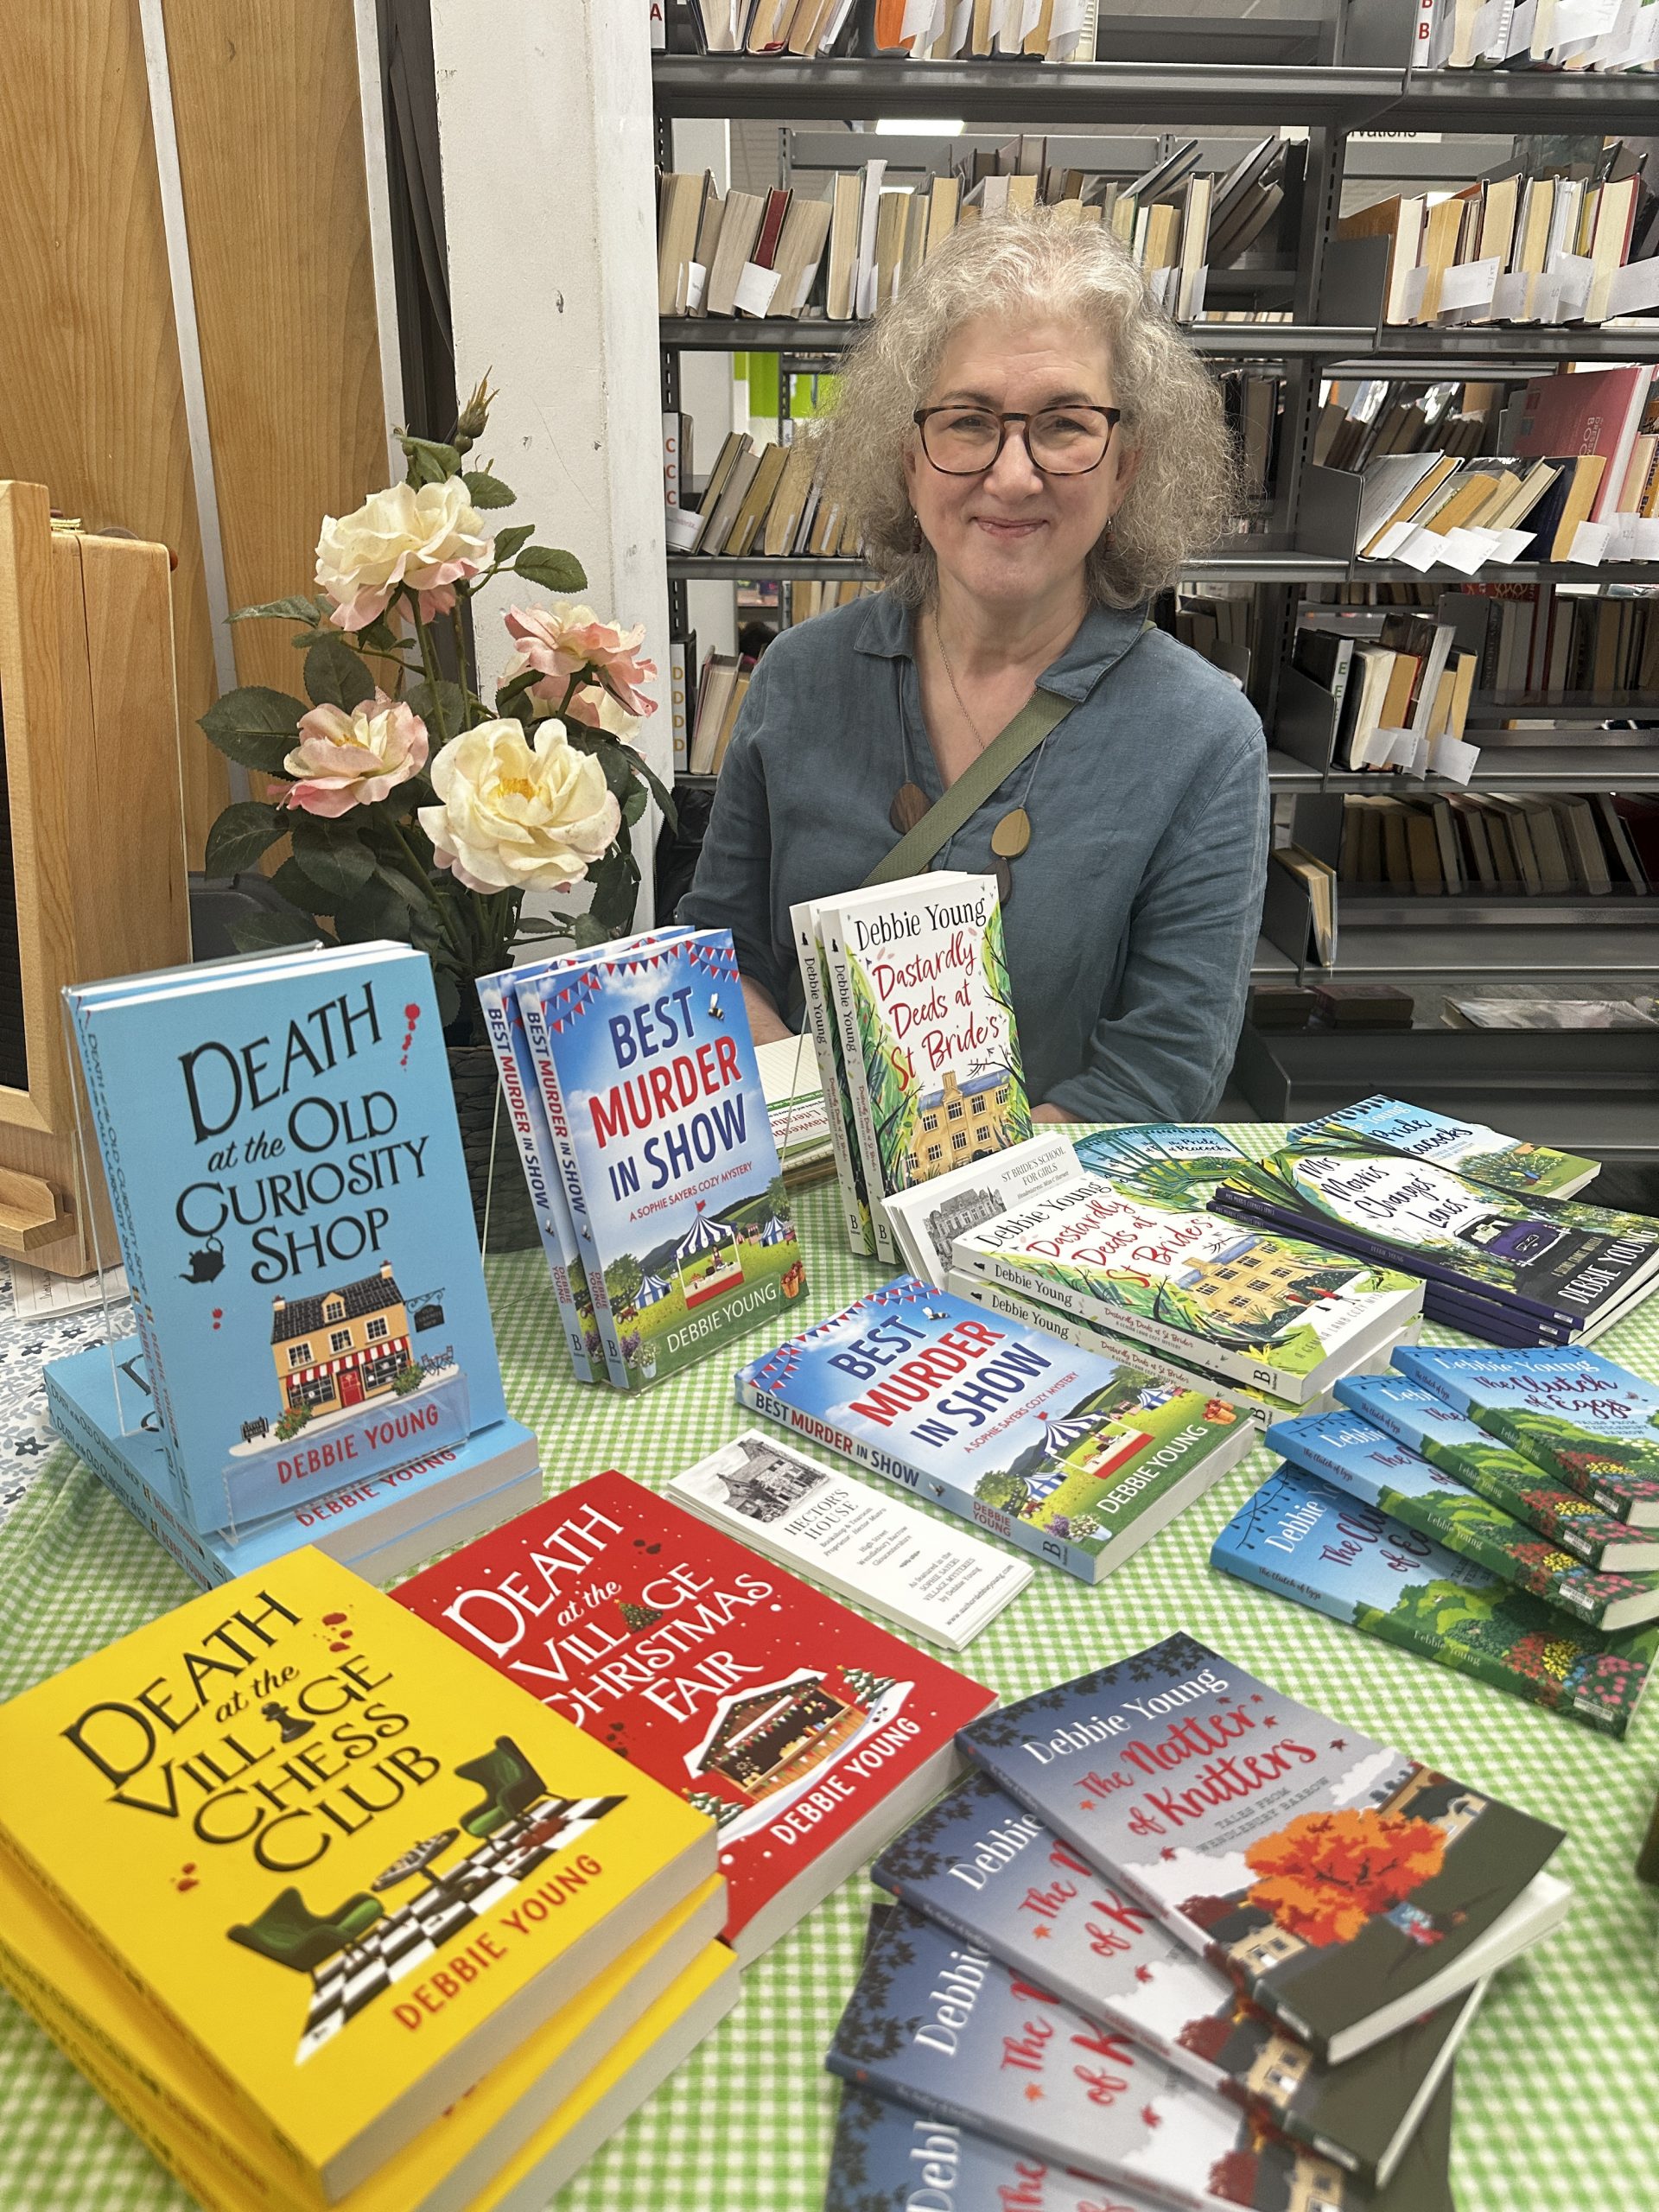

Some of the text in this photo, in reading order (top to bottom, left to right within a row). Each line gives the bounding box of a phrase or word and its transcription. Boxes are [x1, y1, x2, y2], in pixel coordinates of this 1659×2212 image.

[650, 3, 662, 21] A
[1419, 22, 1430, 39] B
[665, 438, 676, 453] C
[666, 464, 676, 479] C
[667, 491, 677, 505] C
[672, 667, 683, 680] D
[1338, 662, 1347, 674] E
[673, 691, 683, 704] D
[674, 715, 684, 728] D
[675, 739, 684, 751] D
[855, 898, 987, 950] Debbie Young
[872, 931, 976, 1001] Dastardly
[804, 957, 827, 1044] Debbie Young
[835, 964, 857, 1052] Debbie Young
[889, 980, 971, 1039] Deeds at
[608, 986, 695, 1070] BEST
[178, 981, 382, 1145] DEATH
[891, 1046, 916, 1091] St
[487, 1008, 550, 1210] BEST MURDER IN SHOW
[526, 1012, 586, 1215] BEST MURDER IN SHOW
[588, 1036, 743, 1148] MURDER
[207, 1091, 397, 1173] at the OLD
[608, 1093, 747, 1202] IN SHOW
[1368, 1118, 1432, 1141] Pride
[176, 1135, 429, 1237] CURIOSITY
[1001, 1146, 1066, 1182] ST BRIDE'S SCHOOL
[1022, 1163, 1058, 1185] FOR GIRLS
[1298, 1157, 1340, 1179] Mrs
[630, 1161, 753, 1223] A SOPHIE SAYERS COZY MYSTERY
[975, 1180, 1112, 1248] Debbie Young
[1354, 1177, 1440, 1218] Changes
[1406, 1198, 1469, 1229] Lanes
[251, 1207, 389, 1284] SHOP
[1026, 1199, 1135, 1257] Dastardly
[1071, 1216, 1157, 1266] Deeds at
[995, 1263, 1073, 1308] Debbie Young
[1106, 1265, 1152, 1289] St
[1558, 1264, 1622, 1306] DEBBIE
[1598, 1228, 1659, 1266] YOUNG
[666, 1282, 778, 1354] DEBBIE YOUNG
[992, 1295, 1070, 1340] Debbie Young
[828, 1314, 928, 1381] BEST
[1434, 1357, 1599, 1374] Debbie Young
[849, 1320, 1008, 1427] MURDER
[910, 1342, 1053, 1448] IN SHOW
[1254, 1370, 1270, 1385] B
[1469, 1373, 1618, 1393] The Clutch
[964, 1371, 1080, 1453] A SOPHIE SAYERS COZY MYSTERY
[1524, 1394, 1632, 1420] of Eggs
[276, 1403, 439, 1484] DEBBIE YOUNG
[755, 1392, 920, 1487] BEST MURDER IN SHOW
[1363, 1451, 1412, 1468] The
[1096, 1424, 1208, 1514] DEBBIE YOUNG
[784, 1489, 849, 1535] HECTOR'S
[804, 1501, 859, 1540] HOUSE
[973, 1502, 1011, 1527] DEBBIE
[973, 1510, 1012, 1538] YOUNG
[1264, 1499, 1327, 1554] Debbie
[1427, 1514, 1484, 1550] Debbie Young
[919, 1557, 960, 1592] SOPHIE SAYERS
[1319, 1540, 1363, 1567] The
[1380, 1549, 1421, 1573] of
[441, 1503, 625, 1660] DEATH
[556, 1580, 622, 1628] at the
[923, 1557, 976, 1601] VILLAGE MYSTERIES
[945, 1580, 966, 1597] Debbie
[962, 1567, 982, 1581] Young
[1271, 1571, 1297, 1590] Clutch
[508, 1561, 715, 1683] VILLGE
[59, 1589, 303, 1790] DEATH
[214, 1664, 301, 1724] at the
[639, 1649, 765, 1723] FAIR
[105, 1653, 394, 1819] VILLGE
[1020, 1668, 1230, 1766] Debbie Young
[192, 1702, 410, 1846] CHESS
[1073, 1770, 1135, 1799] The
[1119, 1703, 1257, 1776] Natter
[770, 1715, 921, 1846] DEBBIE YOUNG
[1127, 1738, 1318, 1837] of Knitters
[1280, 1776, 1330, 1810] BARROW
[253, 1745, 441, 1873] CLUB
[1214, 1786, 1292, 1829] TALES FROM
[947, 1812, 1046, 1891] Debbie
[1019, 1878, 1078, 1919] The
[391, 1853, 604, 2032] DEBBIE YOUNG
[1084, 1922, 1133, 1959] of
[1001, 2016, 1055, 2073] The
[1073, 2064, 1129, 2107] of
